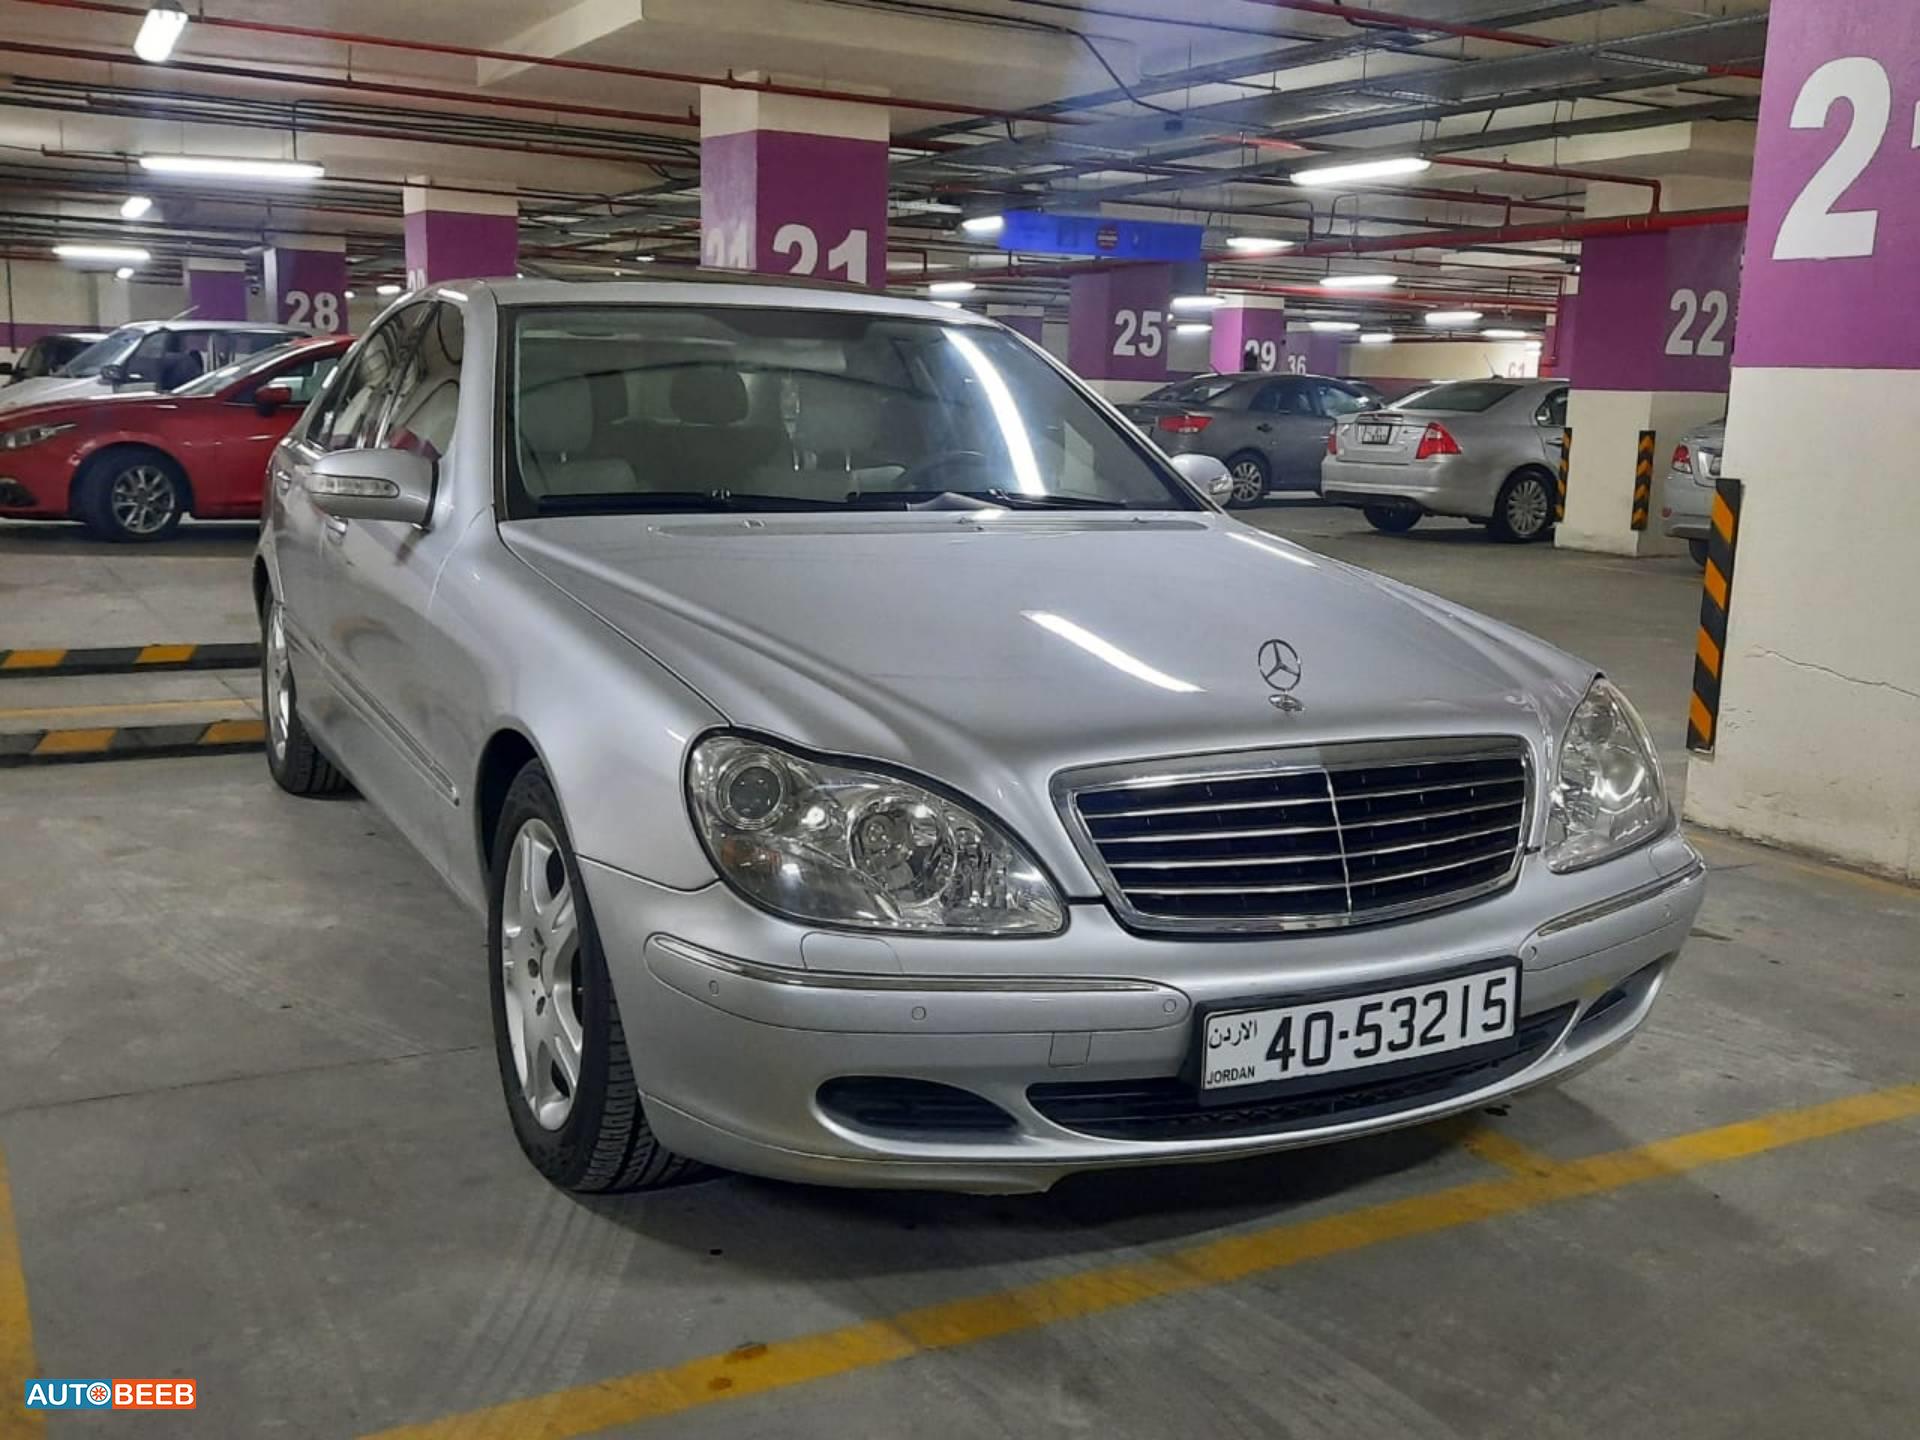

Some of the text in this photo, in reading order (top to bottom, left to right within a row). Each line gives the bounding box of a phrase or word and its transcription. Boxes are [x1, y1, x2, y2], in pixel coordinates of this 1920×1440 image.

[772, 224, 868, 285] 21
[285, 290, 340, 333] 28
[1113, 310, 1162, 357] 25
[1665, 288, 1728, 356] 22
[1265, 977, 1507, 1072] 40-53215
[1206, 1065, 1256, 1085] JORDAN
